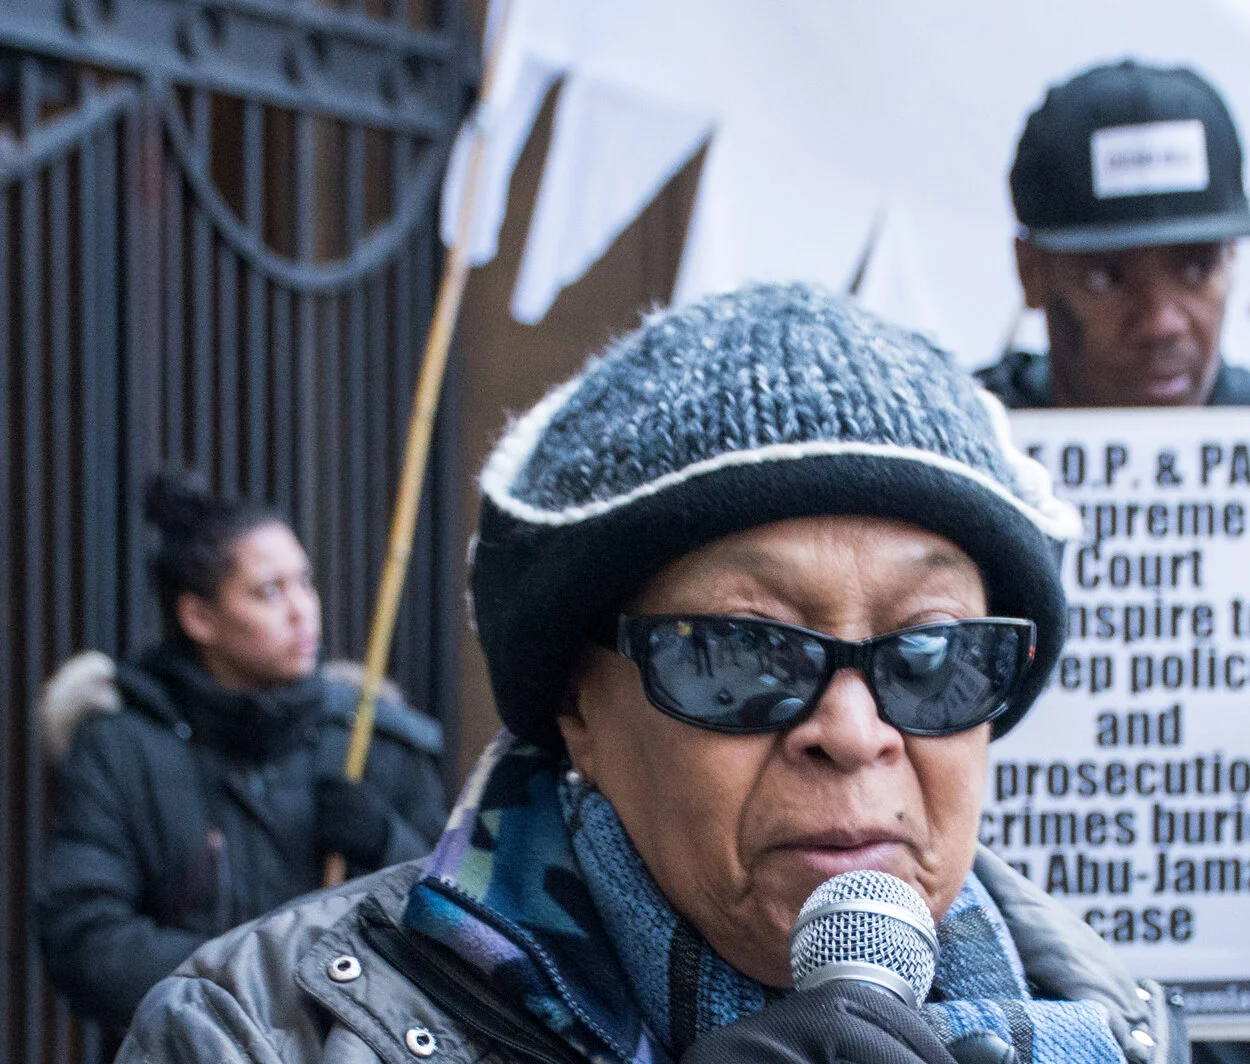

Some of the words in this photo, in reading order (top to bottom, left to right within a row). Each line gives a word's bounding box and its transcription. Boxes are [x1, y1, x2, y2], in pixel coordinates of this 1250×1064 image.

[1154, 451, 1183, 486] &
[1080, 503, 1245, 543] preme
[1076, 548, 1202, 588] Court
[1066, 600, 1214, 643] nspire
[1096, 704, 1182, 747] and
[980, 806, 1136, 847] crimes
[1084, 906, 1194, 944] case
